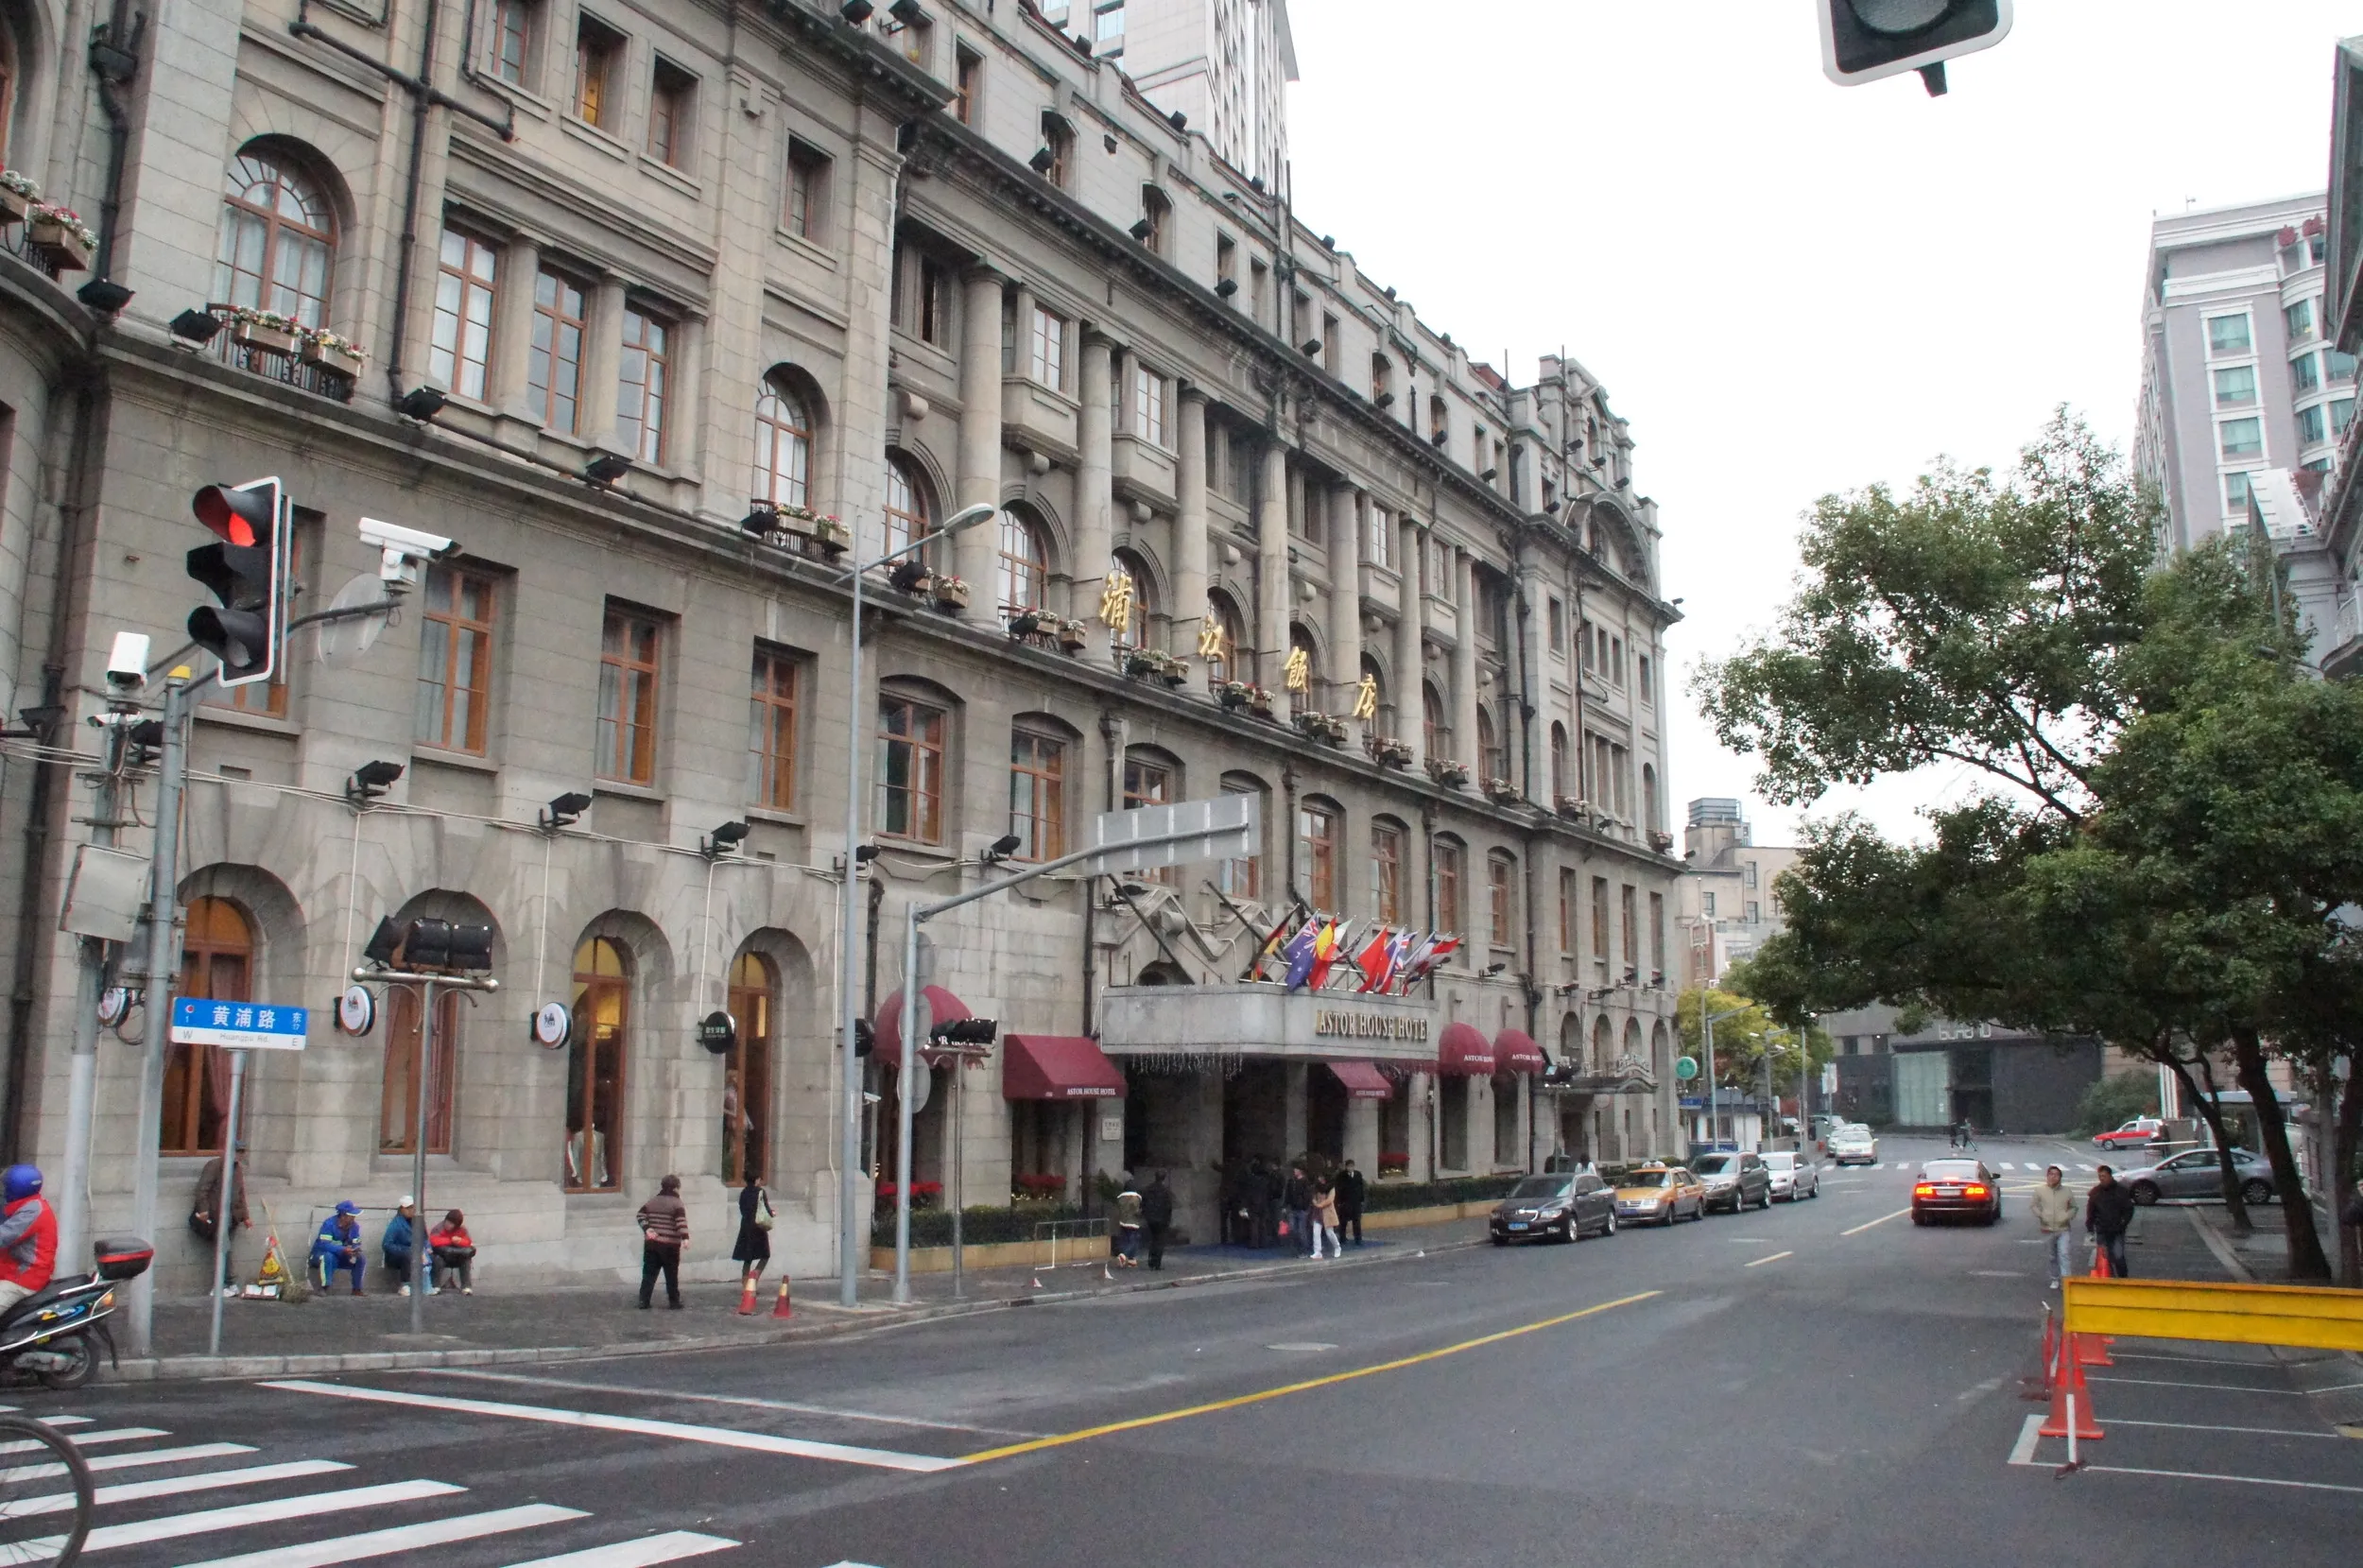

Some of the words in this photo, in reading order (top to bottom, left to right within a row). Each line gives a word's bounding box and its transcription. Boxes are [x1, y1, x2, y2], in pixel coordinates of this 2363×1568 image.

[213, 1005, 276, 1029] 黄浦路
[292, 1012, 302, 1024] 东
[1317, 1009, 1355, 1034] ASTOR
[1359, 1013, 1394, 1037] HOUSE
[182, 1029, 194, 1040] W
[219, 1033, 254, 1042] Huangpu
[291, 1038, 299, 1046] E
[1463, 1054, 1482, 1062] ASTOR
